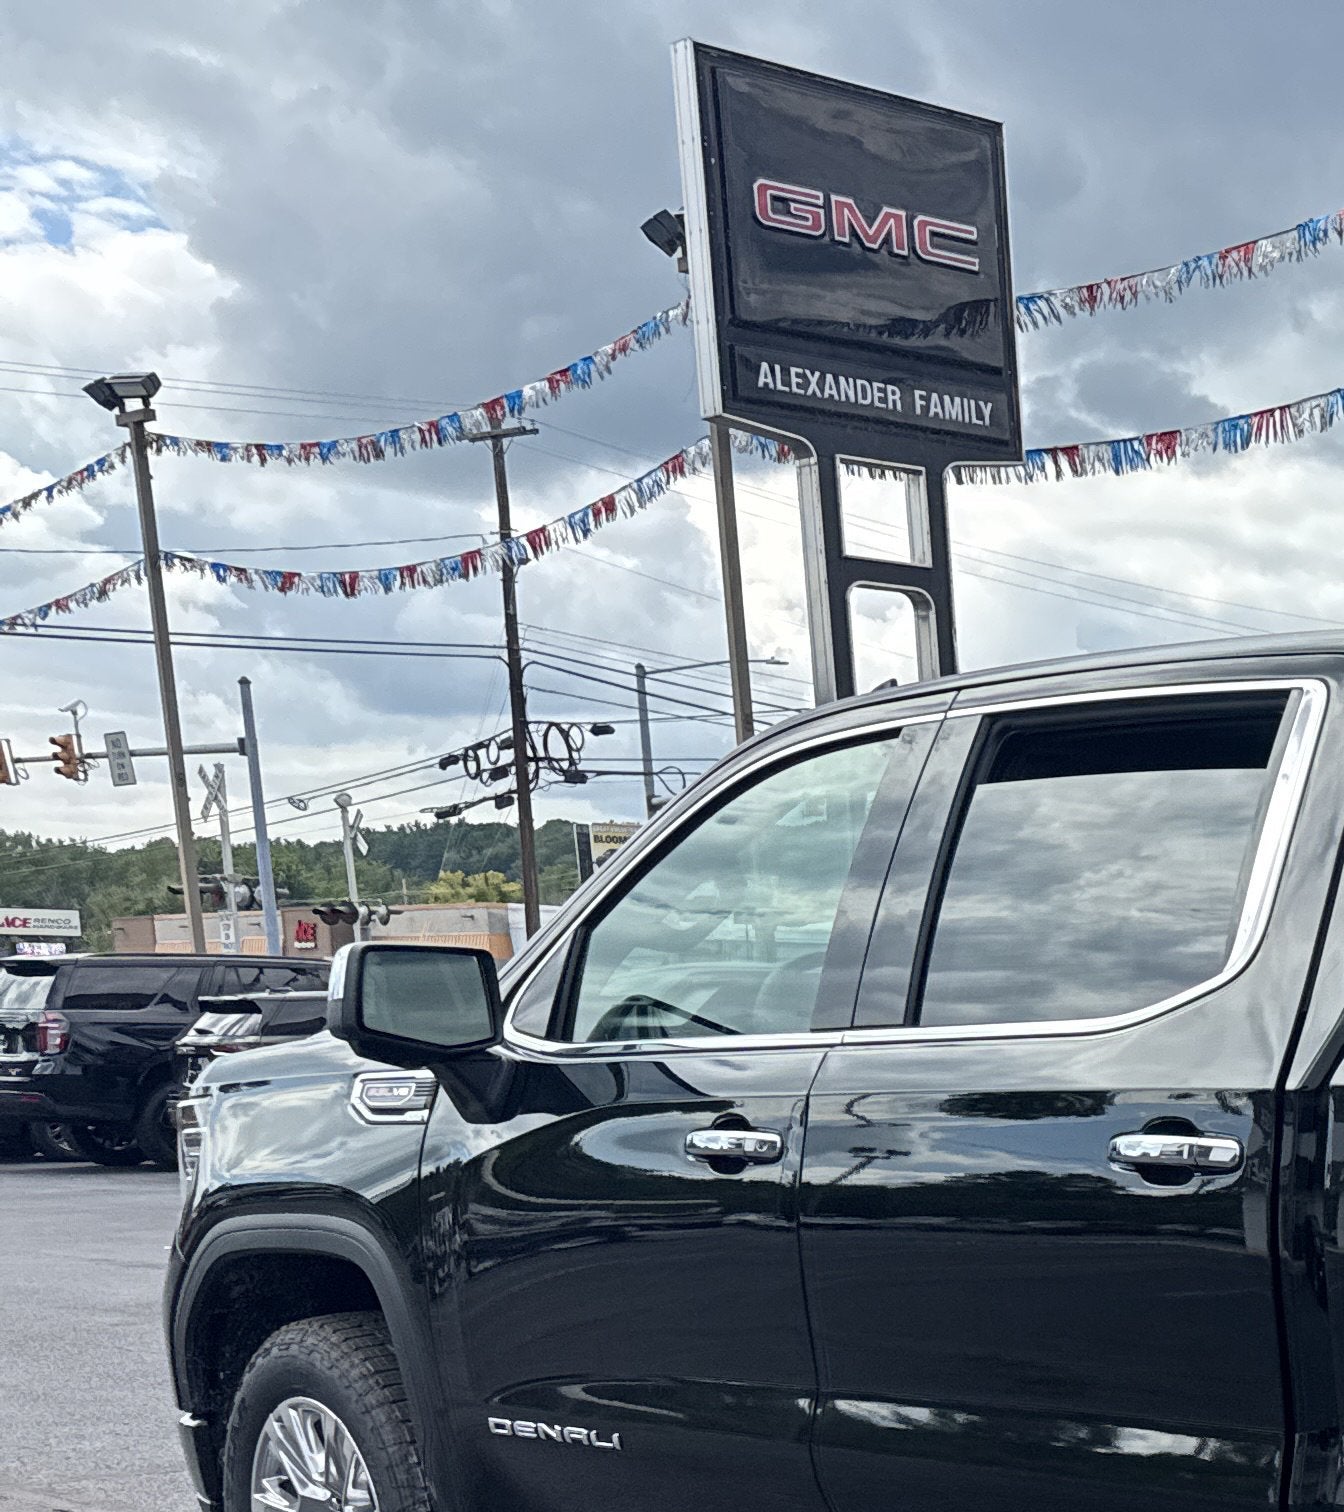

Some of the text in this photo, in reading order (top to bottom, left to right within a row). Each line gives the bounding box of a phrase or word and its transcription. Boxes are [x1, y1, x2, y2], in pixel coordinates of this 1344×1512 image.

[753, 176, 980, 272] GMC
[757, 361, 993, 427] ALEXANDER FAMILY
[488, 1417, 622, 1450] DENALI
